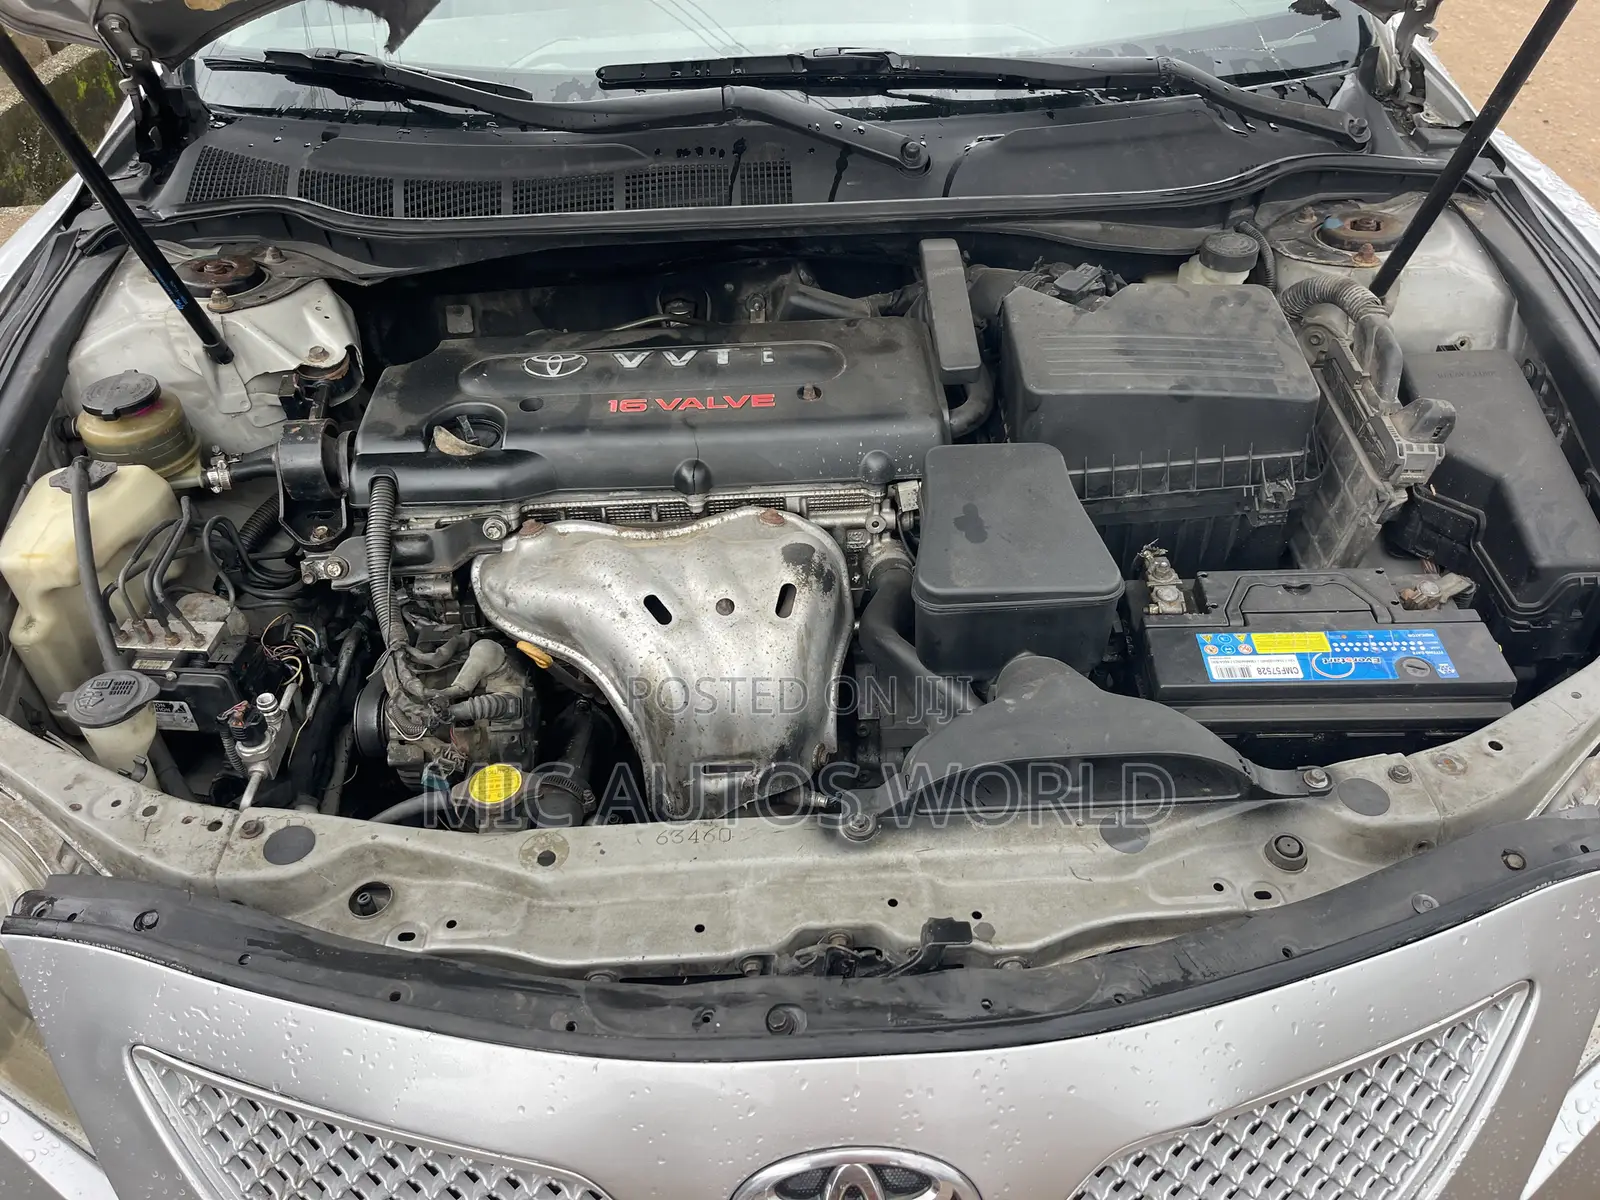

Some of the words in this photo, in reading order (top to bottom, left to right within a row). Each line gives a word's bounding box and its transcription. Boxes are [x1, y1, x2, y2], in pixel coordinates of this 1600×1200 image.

[608, 398, 648, 413] 16
[655, 393, 776, 411] VALVE
[1321, 656, 1382, 666] Everstart
[1257, 666, 1300, 675] CMF57528
[655, 827, 732, 846] 63460
